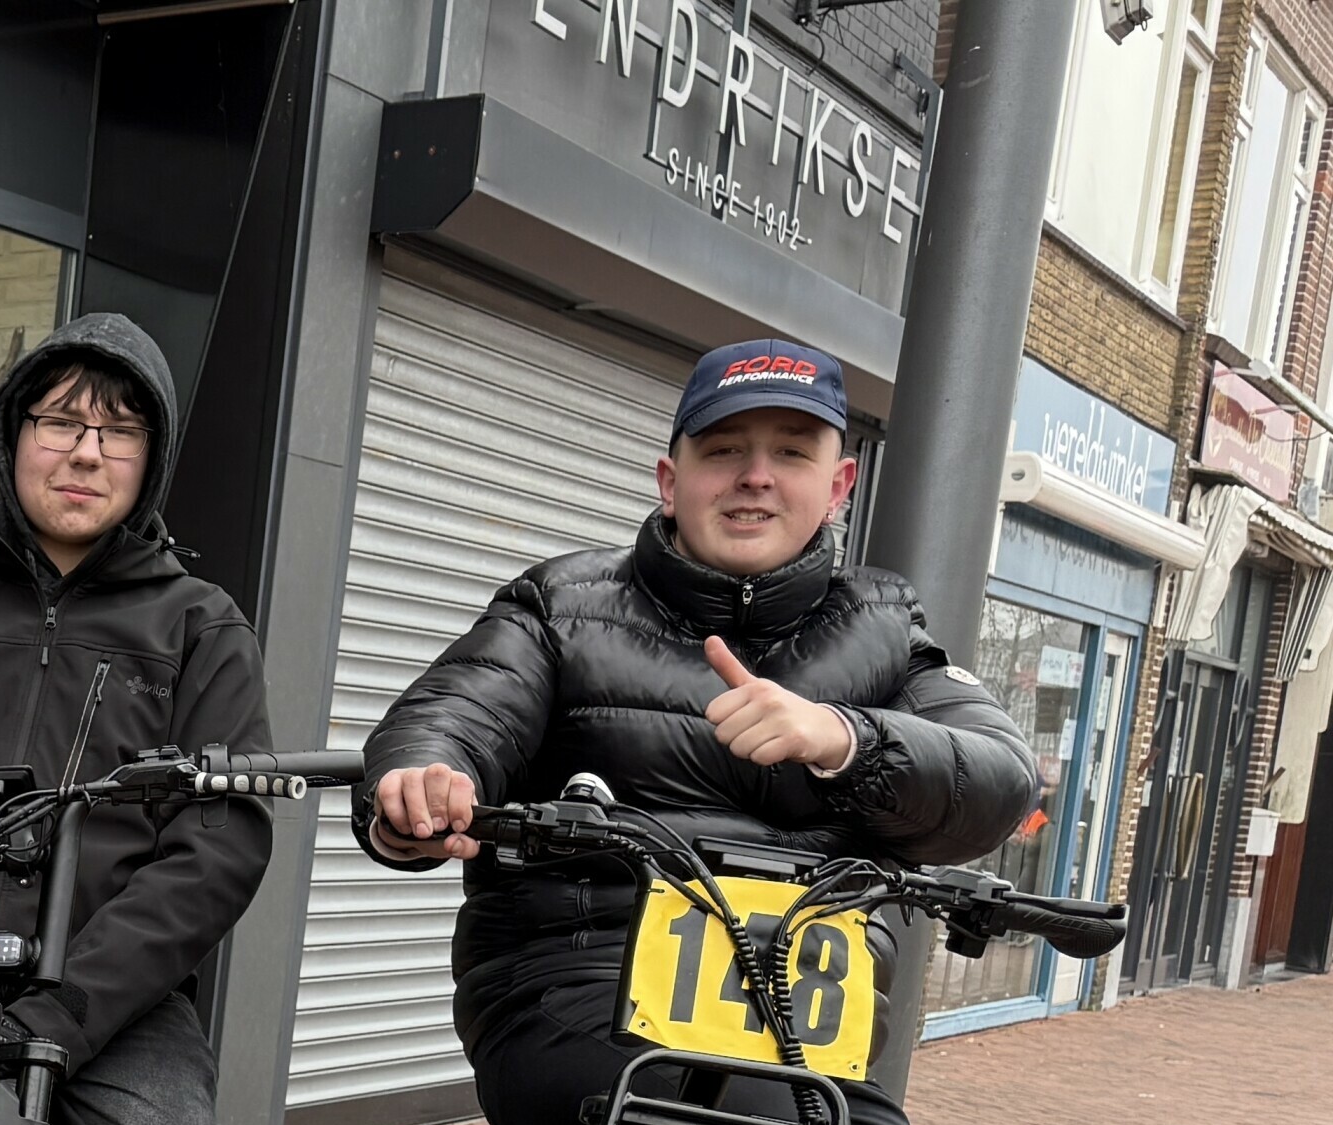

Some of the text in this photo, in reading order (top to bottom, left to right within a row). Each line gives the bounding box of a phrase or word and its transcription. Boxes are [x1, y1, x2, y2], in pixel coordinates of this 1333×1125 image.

[666, 147, 801, 250] SINCE 1902
[717, 371, 815, 389] PERFORMANCE
[724, 355, 817, 378] FORD
[1041, 400, 1153, 508] wereldwinkel
[669, 905, 849, 1046] 148
